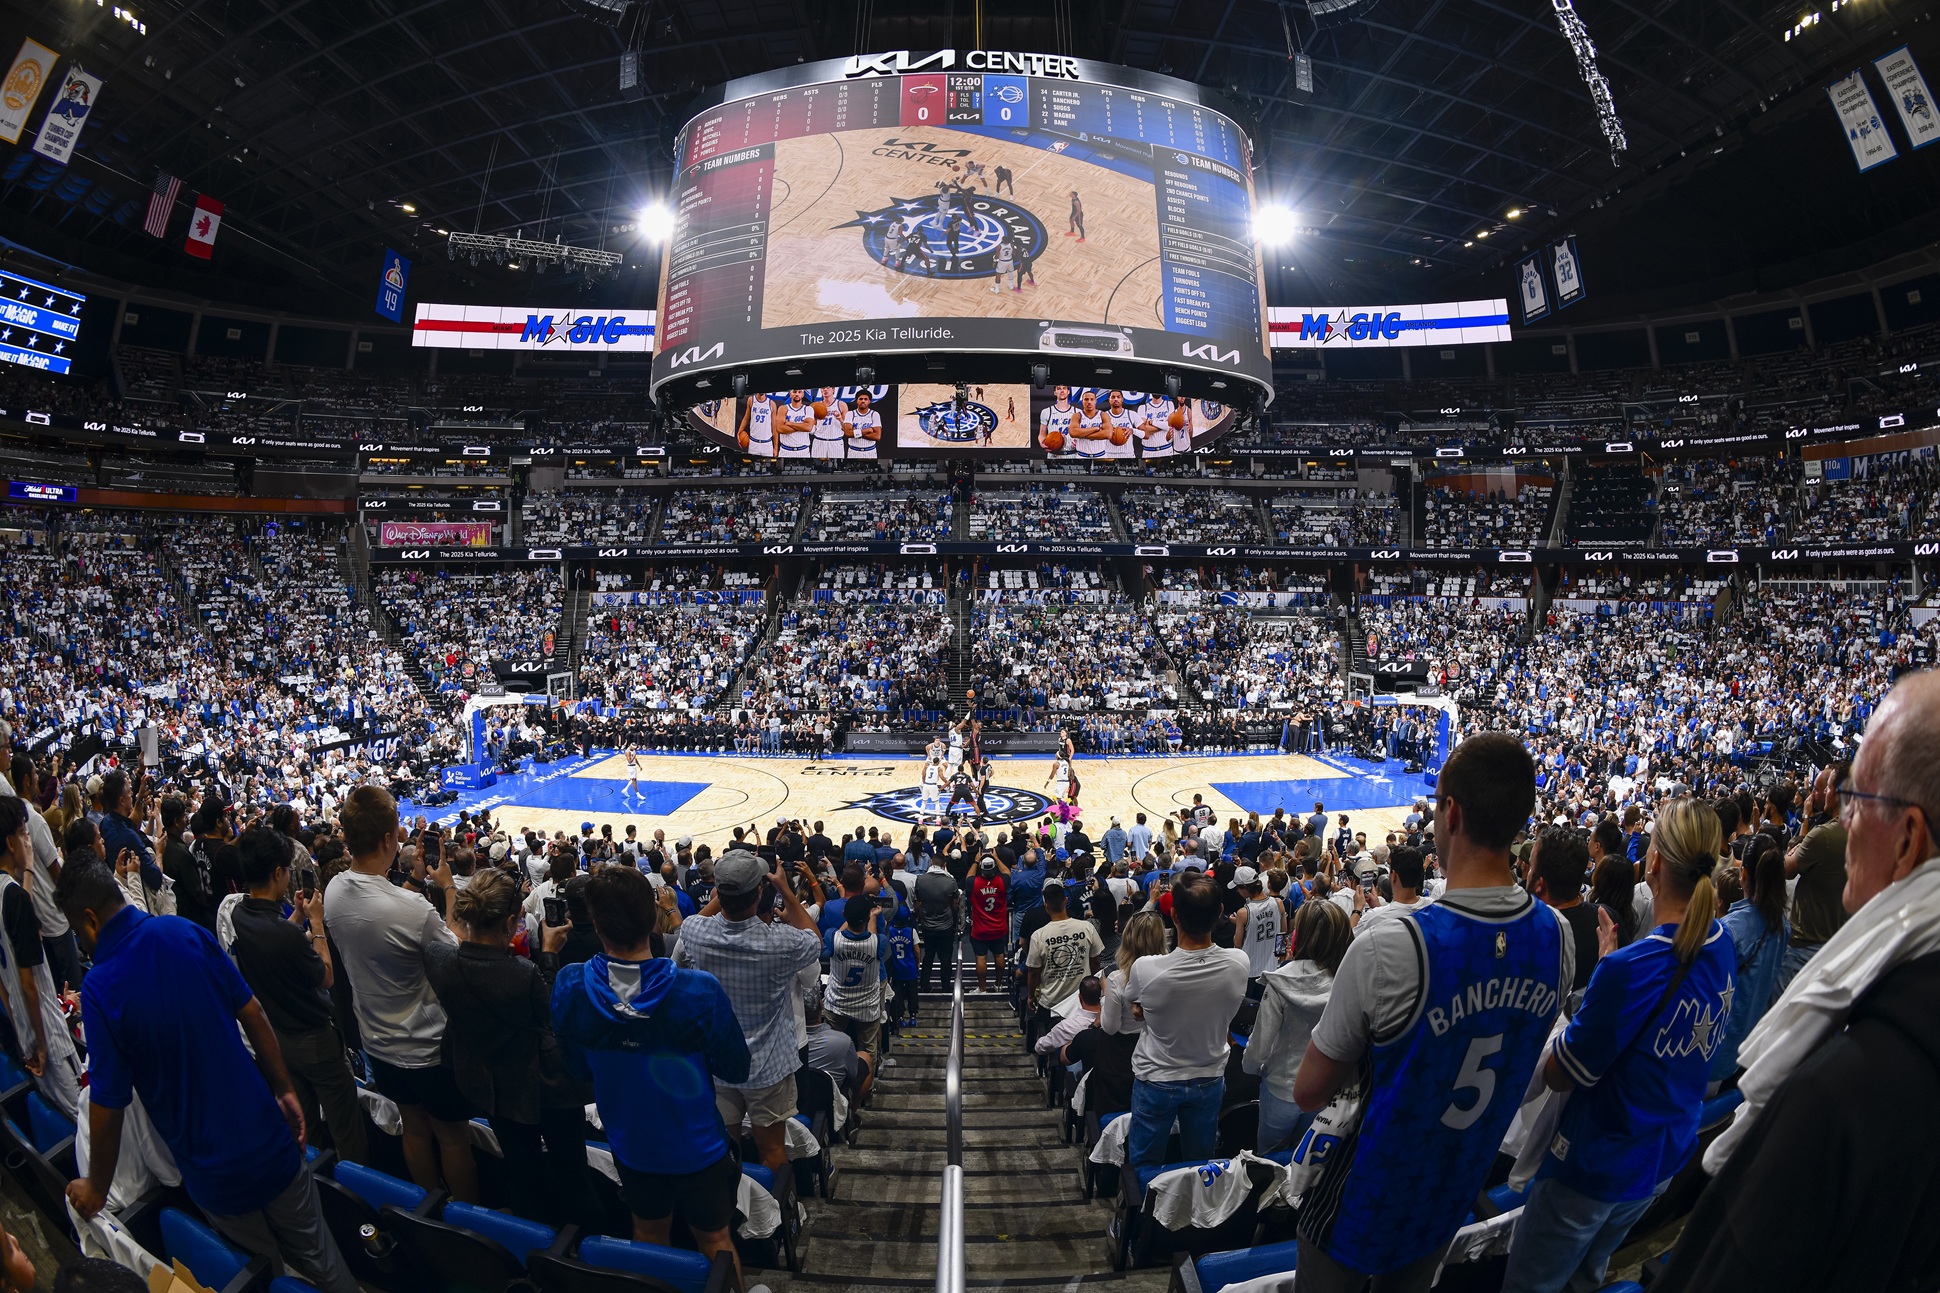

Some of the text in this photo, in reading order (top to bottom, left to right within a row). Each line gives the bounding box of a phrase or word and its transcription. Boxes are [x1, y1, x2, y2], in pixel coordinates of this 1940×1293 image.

[966, 50, 1079, 78] CENTER
[950, 77, 981, 87] 12:00
[772, 94, 788, 102] REBS
[1053, 97, 1080, 106] BANCHERO
[1130, 94, 1146, 102] REBS
[918, 107, 928, 120] 0
[1001, 107, 1011, 121] 0
[1054, 112, 1076, 120] WAGNER
[704, 148, 760, 171] TEAM NUMBERS
[872, 147, 958, 168] CENTER
[1164, 170, 1188, 180] REBOUNDS
[1191, 156, 1240, 182] TEAM NUMBERS
[1174, 180, 1198, 191] REBOUNDS
[1167, 196, 1186, 206] ASSISTS
[1176, 189, 1193, 199] CHANCE
[1193, 193, 1209, 203] POINTS
[1168, 205, 1185, 214] BLOCKS
[1168, 214, 1185, 223] STEALS
[1172, 266, 1200, 278] TEAM FOULS
[1559, 261, 1573, 284] 32
[1173, 276, 1200, 287] TURNOVERS
[1174, 286, 1190, 295] POINTS
[1528, 279, 1536, 299] 6
[385, 290, 397, 311] 49
[1174, 296, 1186, 304] FAST
[1186, 298, 1201, 307] BREAK
[1175, 306, 1207, 318] BENCH POINTS
[52, 320, 69, 332] MAKE
[70, 324, 76, 332] IT
[1176, 316, 1207, 328] BIGGEST LEAD
[800, 327, 954, 345] The 2025 Kia Telluride.
[756, 415, 765, 423] 93
[823, 417, 832, 426] 21
[45, 487, 63, 495] ULTRA
[980, 887, 997, 895] WADE
[984, 897, 995, 912] 3
[1256, 922, 1275, 942] 22
[1045, 932, 1085, 946] 1989-90
[896, 944, 904, 959] 5
[837, 952, 875, 964] BANCHERO
[843, 967, 865, 986] 5
[1426, 976, 1557, 1038] BANCHERO
[1440, 1032, 1504, 1130] 5
